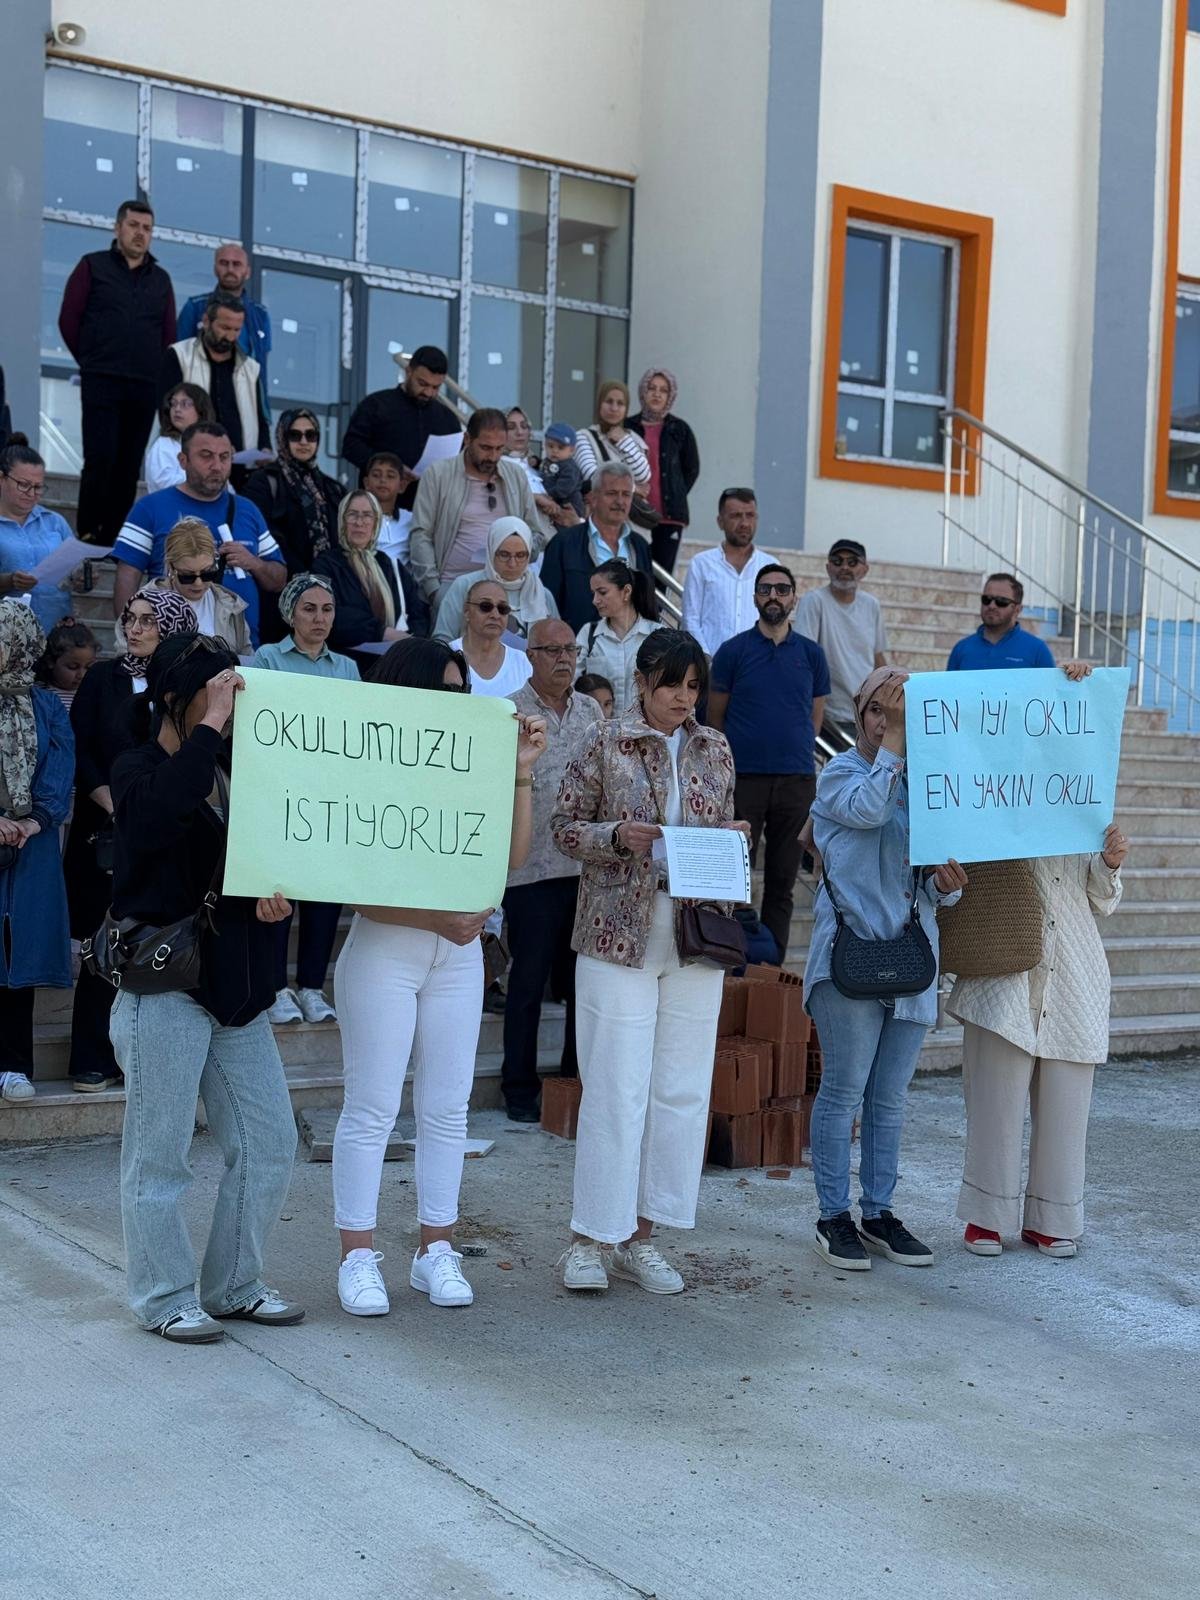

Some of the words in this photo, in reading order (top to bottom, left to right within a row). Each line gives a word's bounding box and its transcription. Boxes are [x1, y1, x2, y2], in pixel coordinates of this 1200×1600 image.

[254, 709, 472, 772] OKULUMUZU
[923, 699, 959, 735] EN
[1024, 698, 1095, 737] OKUL
[926, 773, 960, 810] EN
[972, 773, 1034, 809] YAKIN
[1045, 773, 1102, 806] OKUL
[285, 789, 486, 857] İSTİYORUZ
